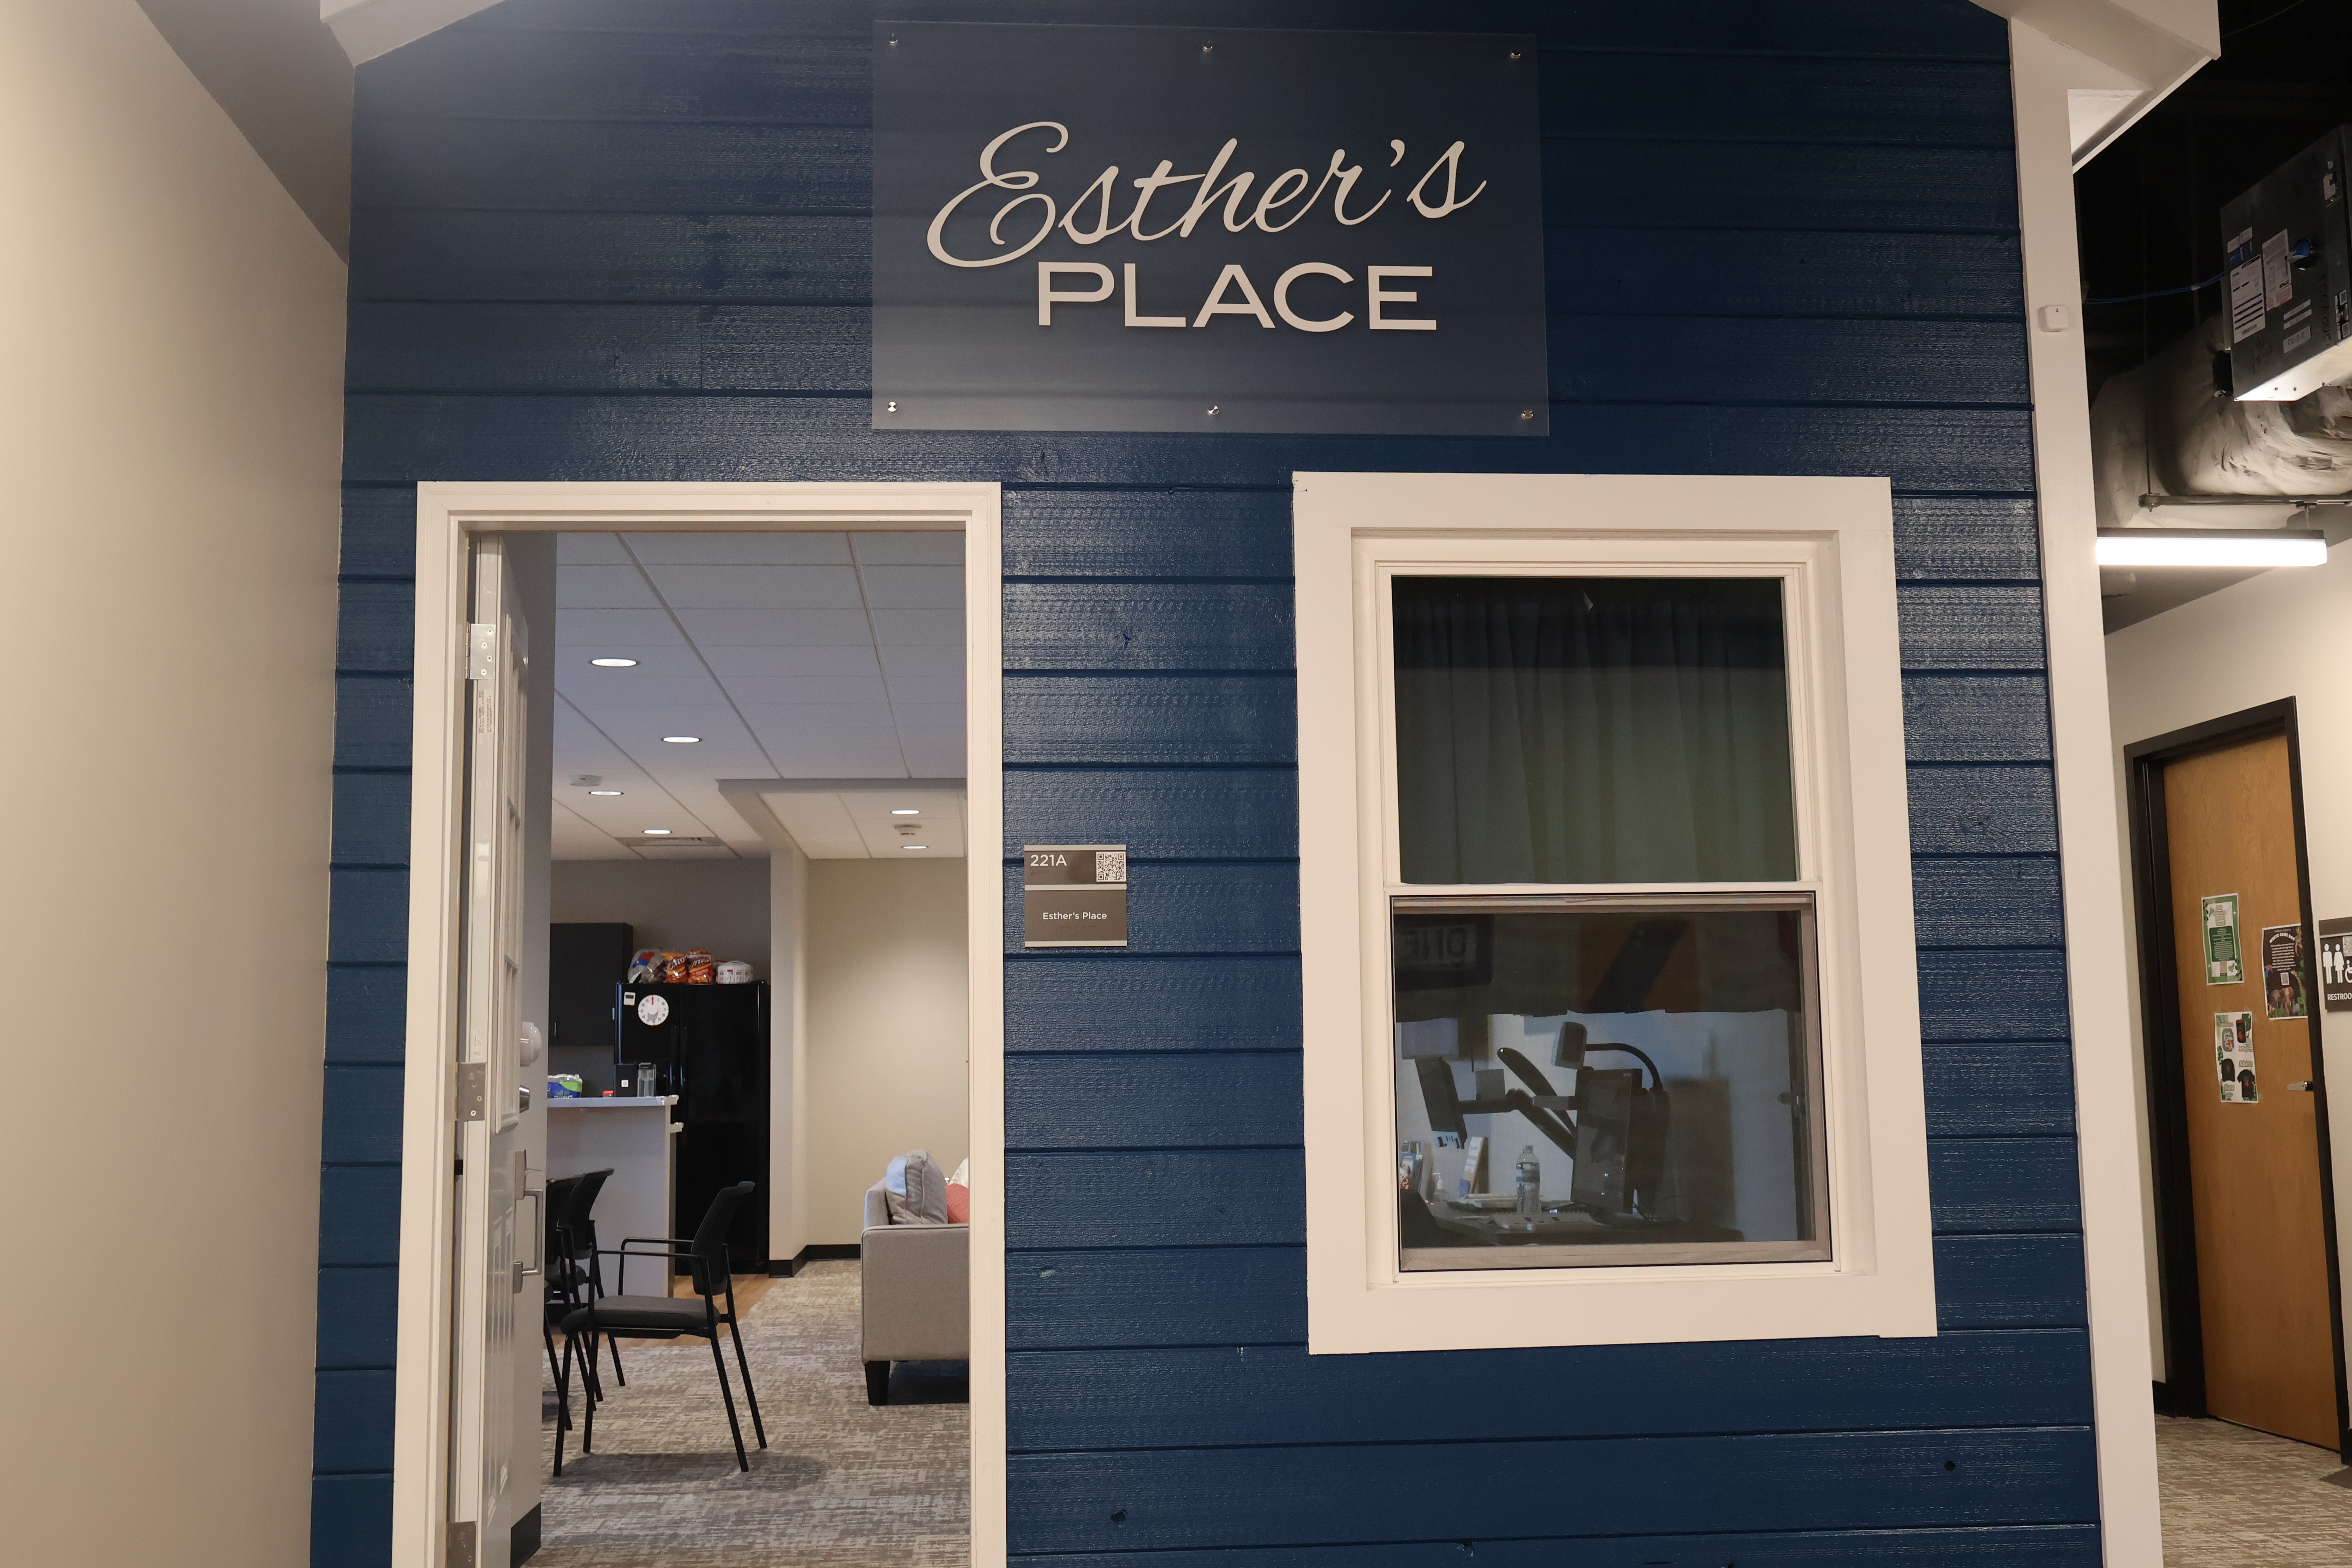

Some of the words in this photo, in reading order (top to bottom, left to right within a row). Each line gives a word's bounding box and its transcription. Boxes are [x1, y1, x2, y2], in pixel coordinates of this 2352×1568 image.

[927, 122, 1487, 267] Esther's
[1038, 262, 1437, 332] PLACE
[1030, 854, 1067, 866] 221A
[1082, 911, 1107, 920] Place
[2327, 993, 2352, 1001] RESTROO
